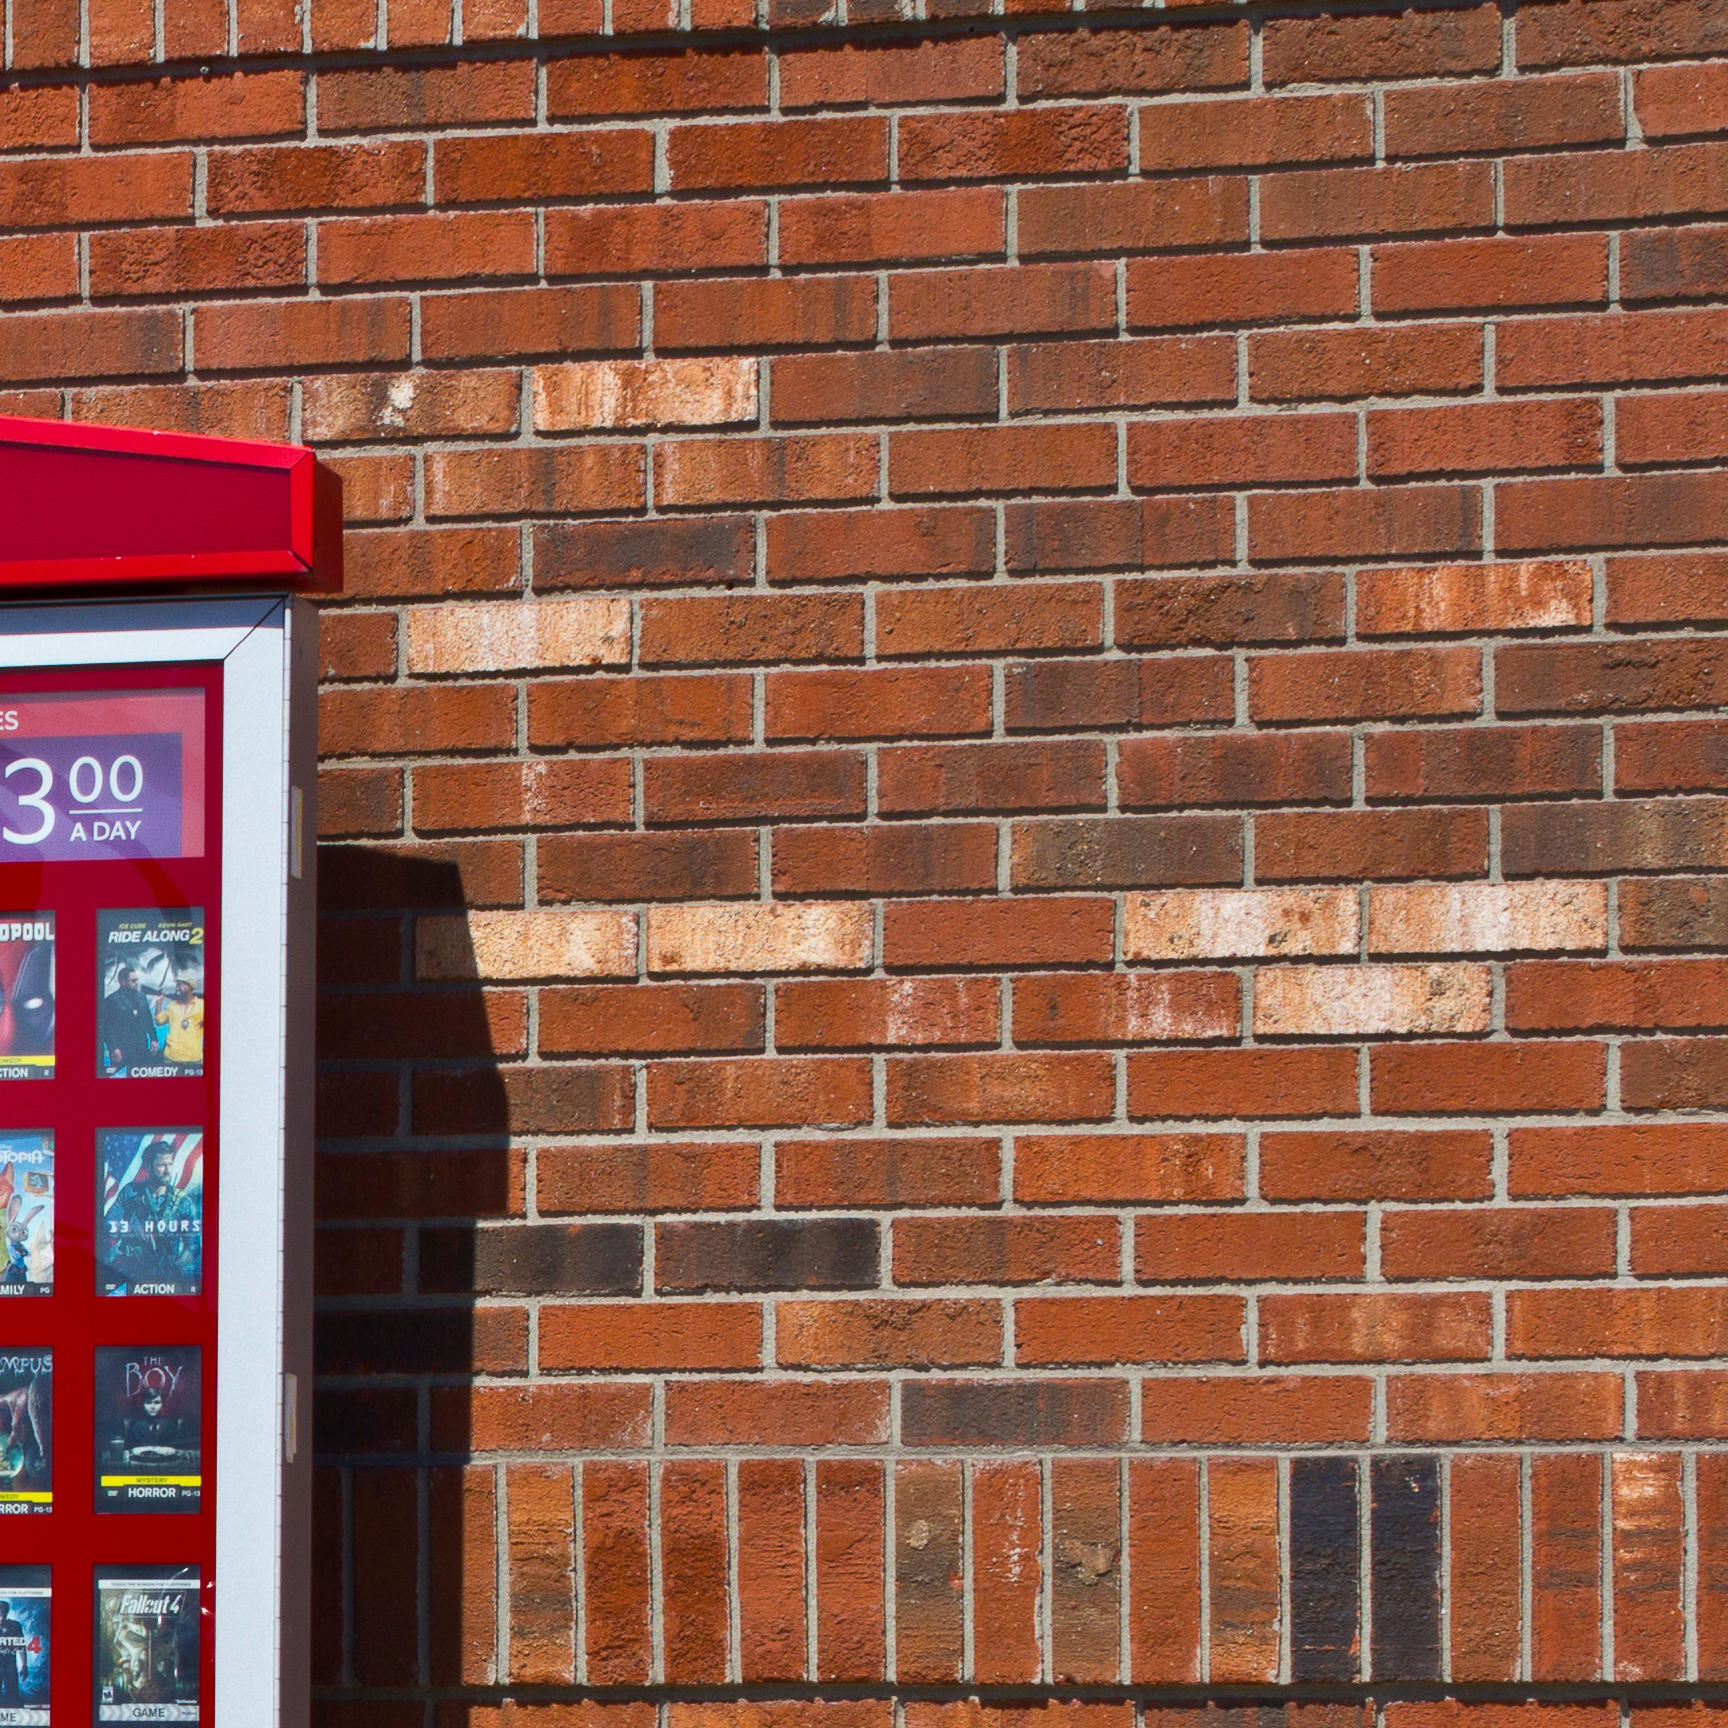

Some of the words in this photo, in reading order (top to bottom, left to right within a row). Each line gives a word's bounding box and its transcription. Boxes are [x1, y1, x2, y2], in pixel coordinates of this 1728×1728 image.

[69, 823, 86, 841] A
[93, 821, 140, 841] DAY
[109, 930, 142, 943] RIDE
[144, 930, 190, 943] ALONG
[189, 928, 203, 944] 2
[110, 1220, 128, 1234] 13
[145, 1219, 200, 1233] HOURS
[126, 1362, 182, 1397] BOY
[120, 1595, 167, 1614] Fallout
[169, 1594, 182, 1614] 4
[27, 1636, 41, 1653] 4
